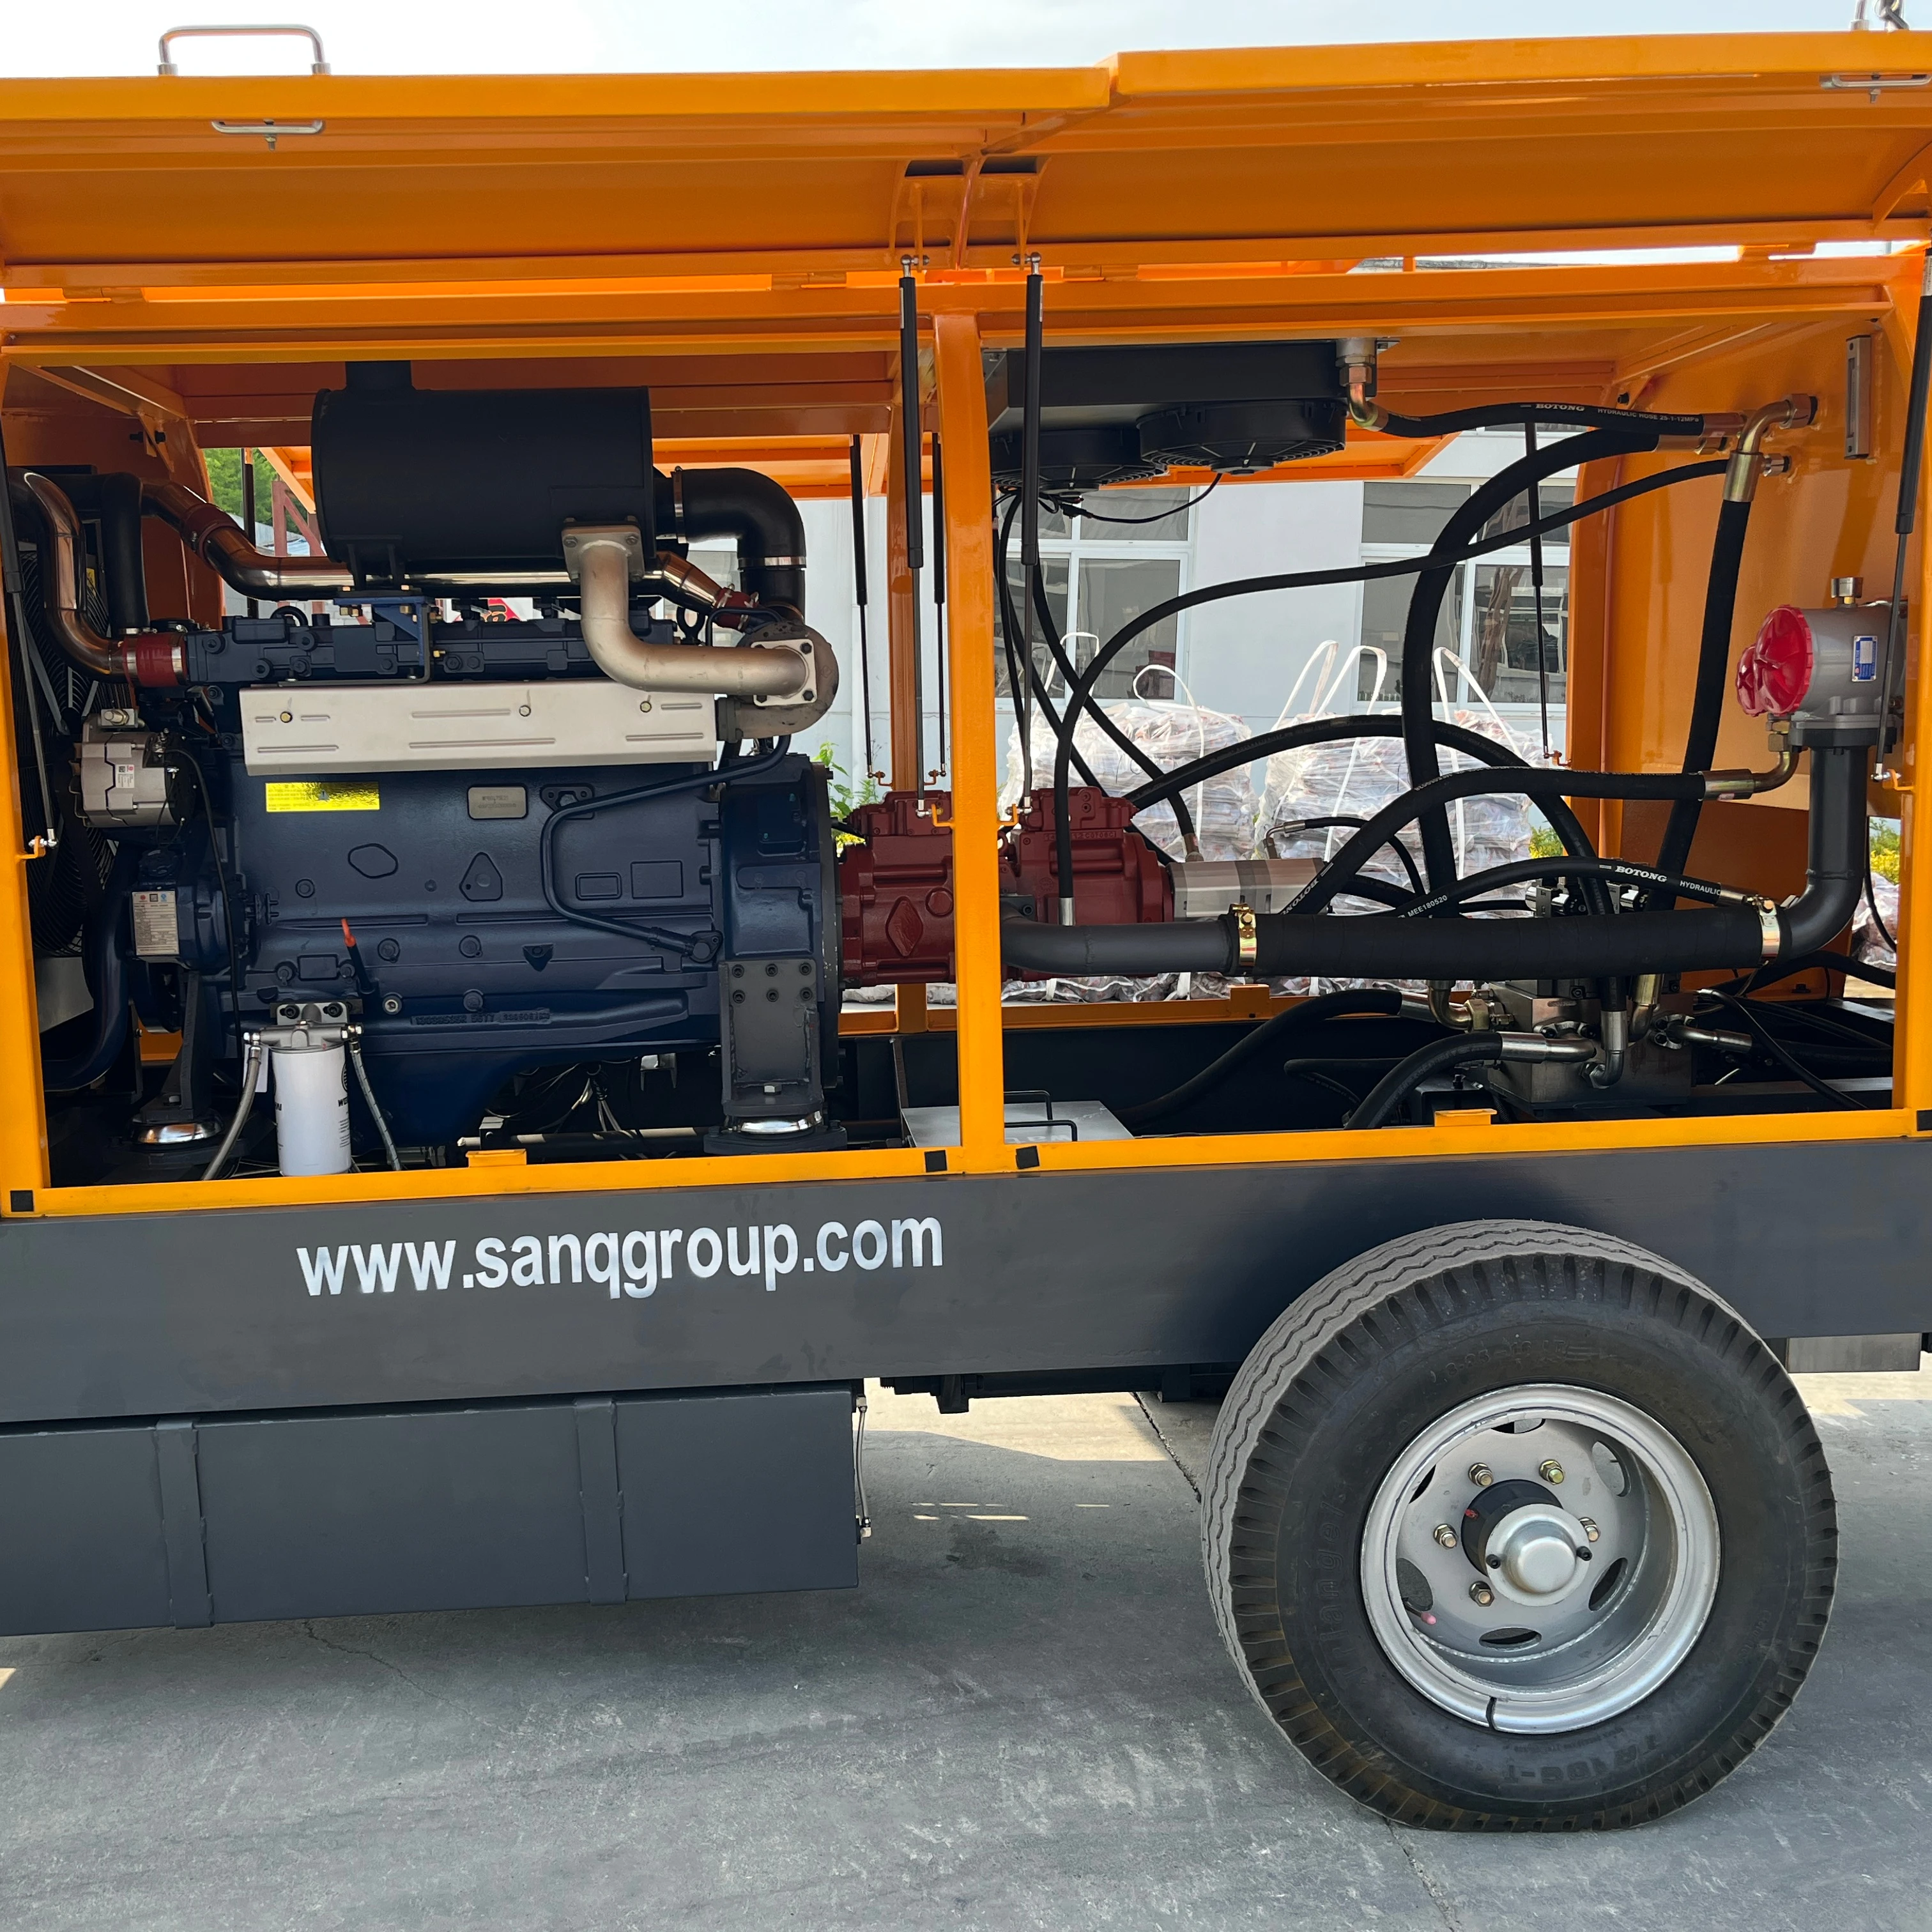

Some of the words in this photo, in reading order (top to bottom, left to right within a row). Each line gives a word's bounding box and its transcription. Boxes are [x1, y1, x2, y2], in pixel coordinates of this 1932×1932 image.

[1535, 403, 1584, 411] BOTONG
[1598, 408, 1637, 418] HYDRAULIC
[1615, 865, 1667, 883] BOTONG
[1680, 880, 1721, 896] HYDRAULIC
[296, 1216, 943, 1300] www.sanqgroup.com
